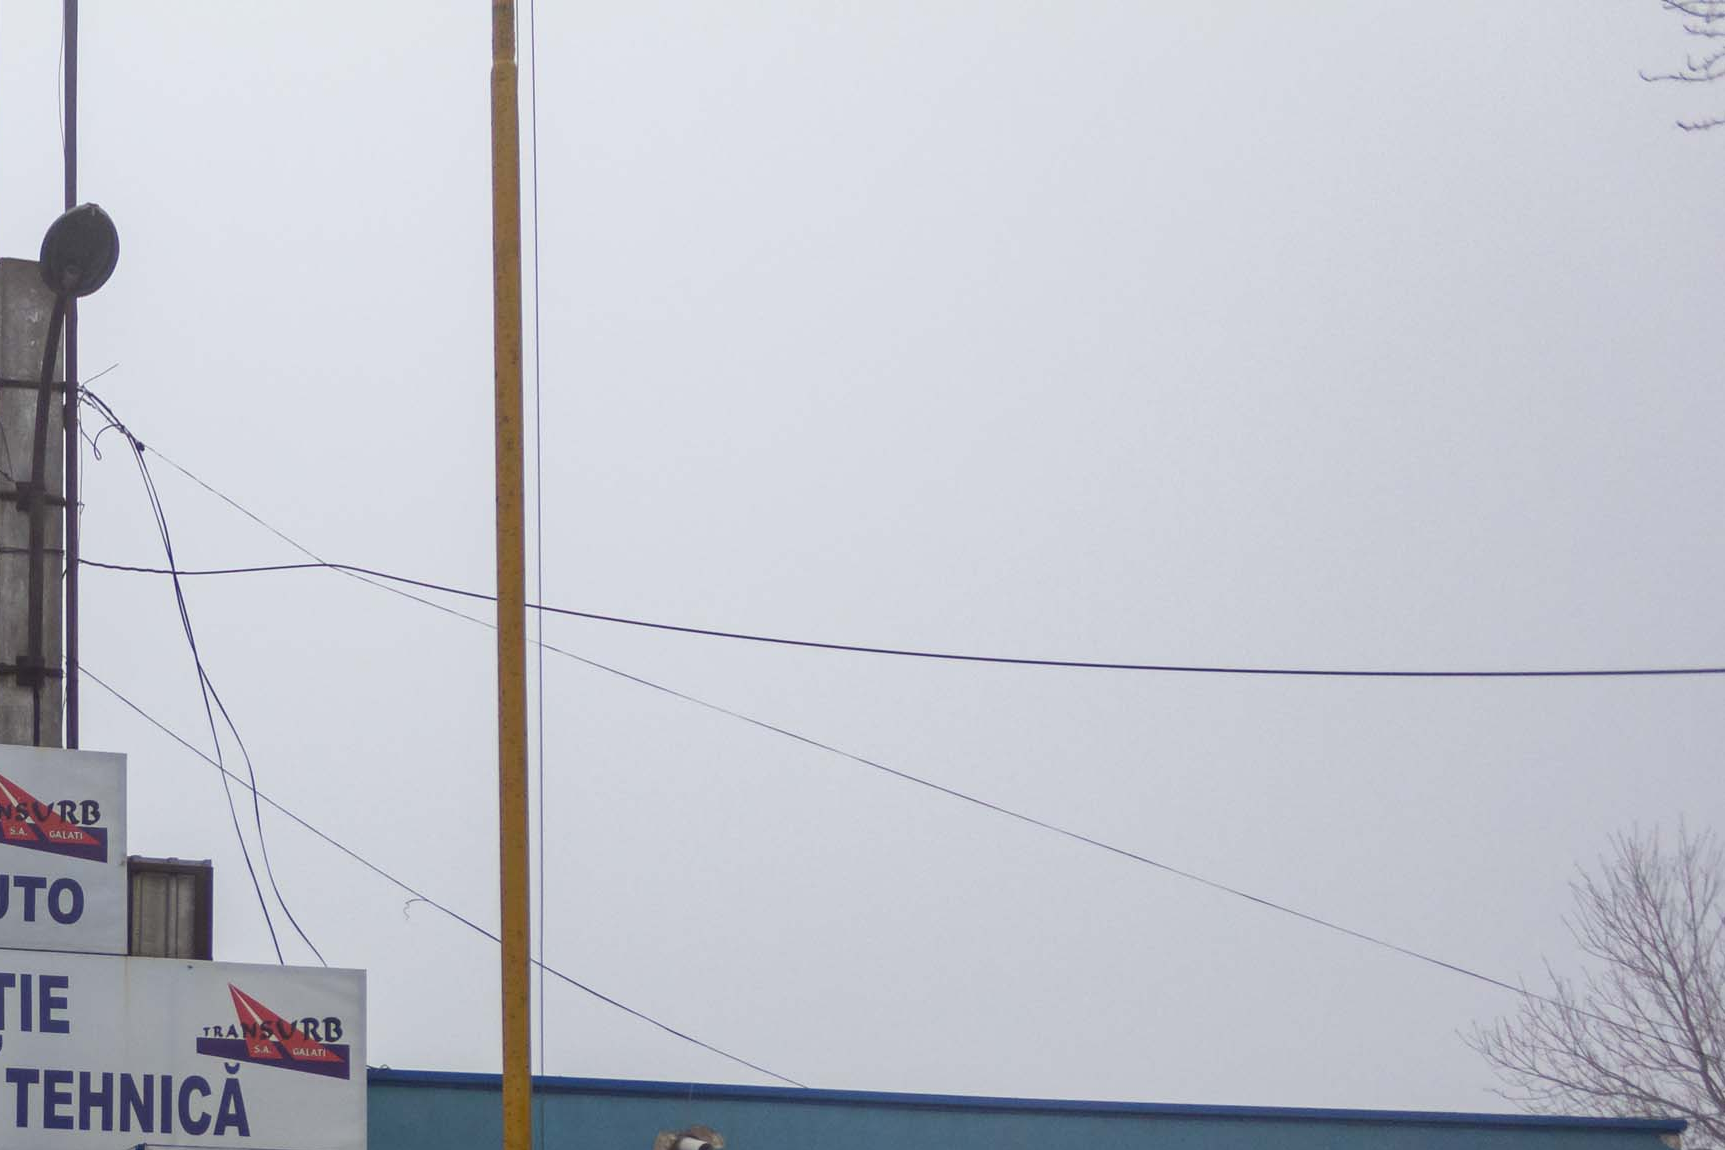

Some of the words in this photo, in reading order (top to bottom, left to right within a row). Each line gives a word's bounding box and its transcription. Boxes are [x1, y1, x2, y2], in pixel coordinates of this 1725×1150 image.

[10, 827, 27, 836] S.A.
[203, 1017, 343, 1043] TRANSURB
[5, 1062, 251, 1137] TEHNICĂ
